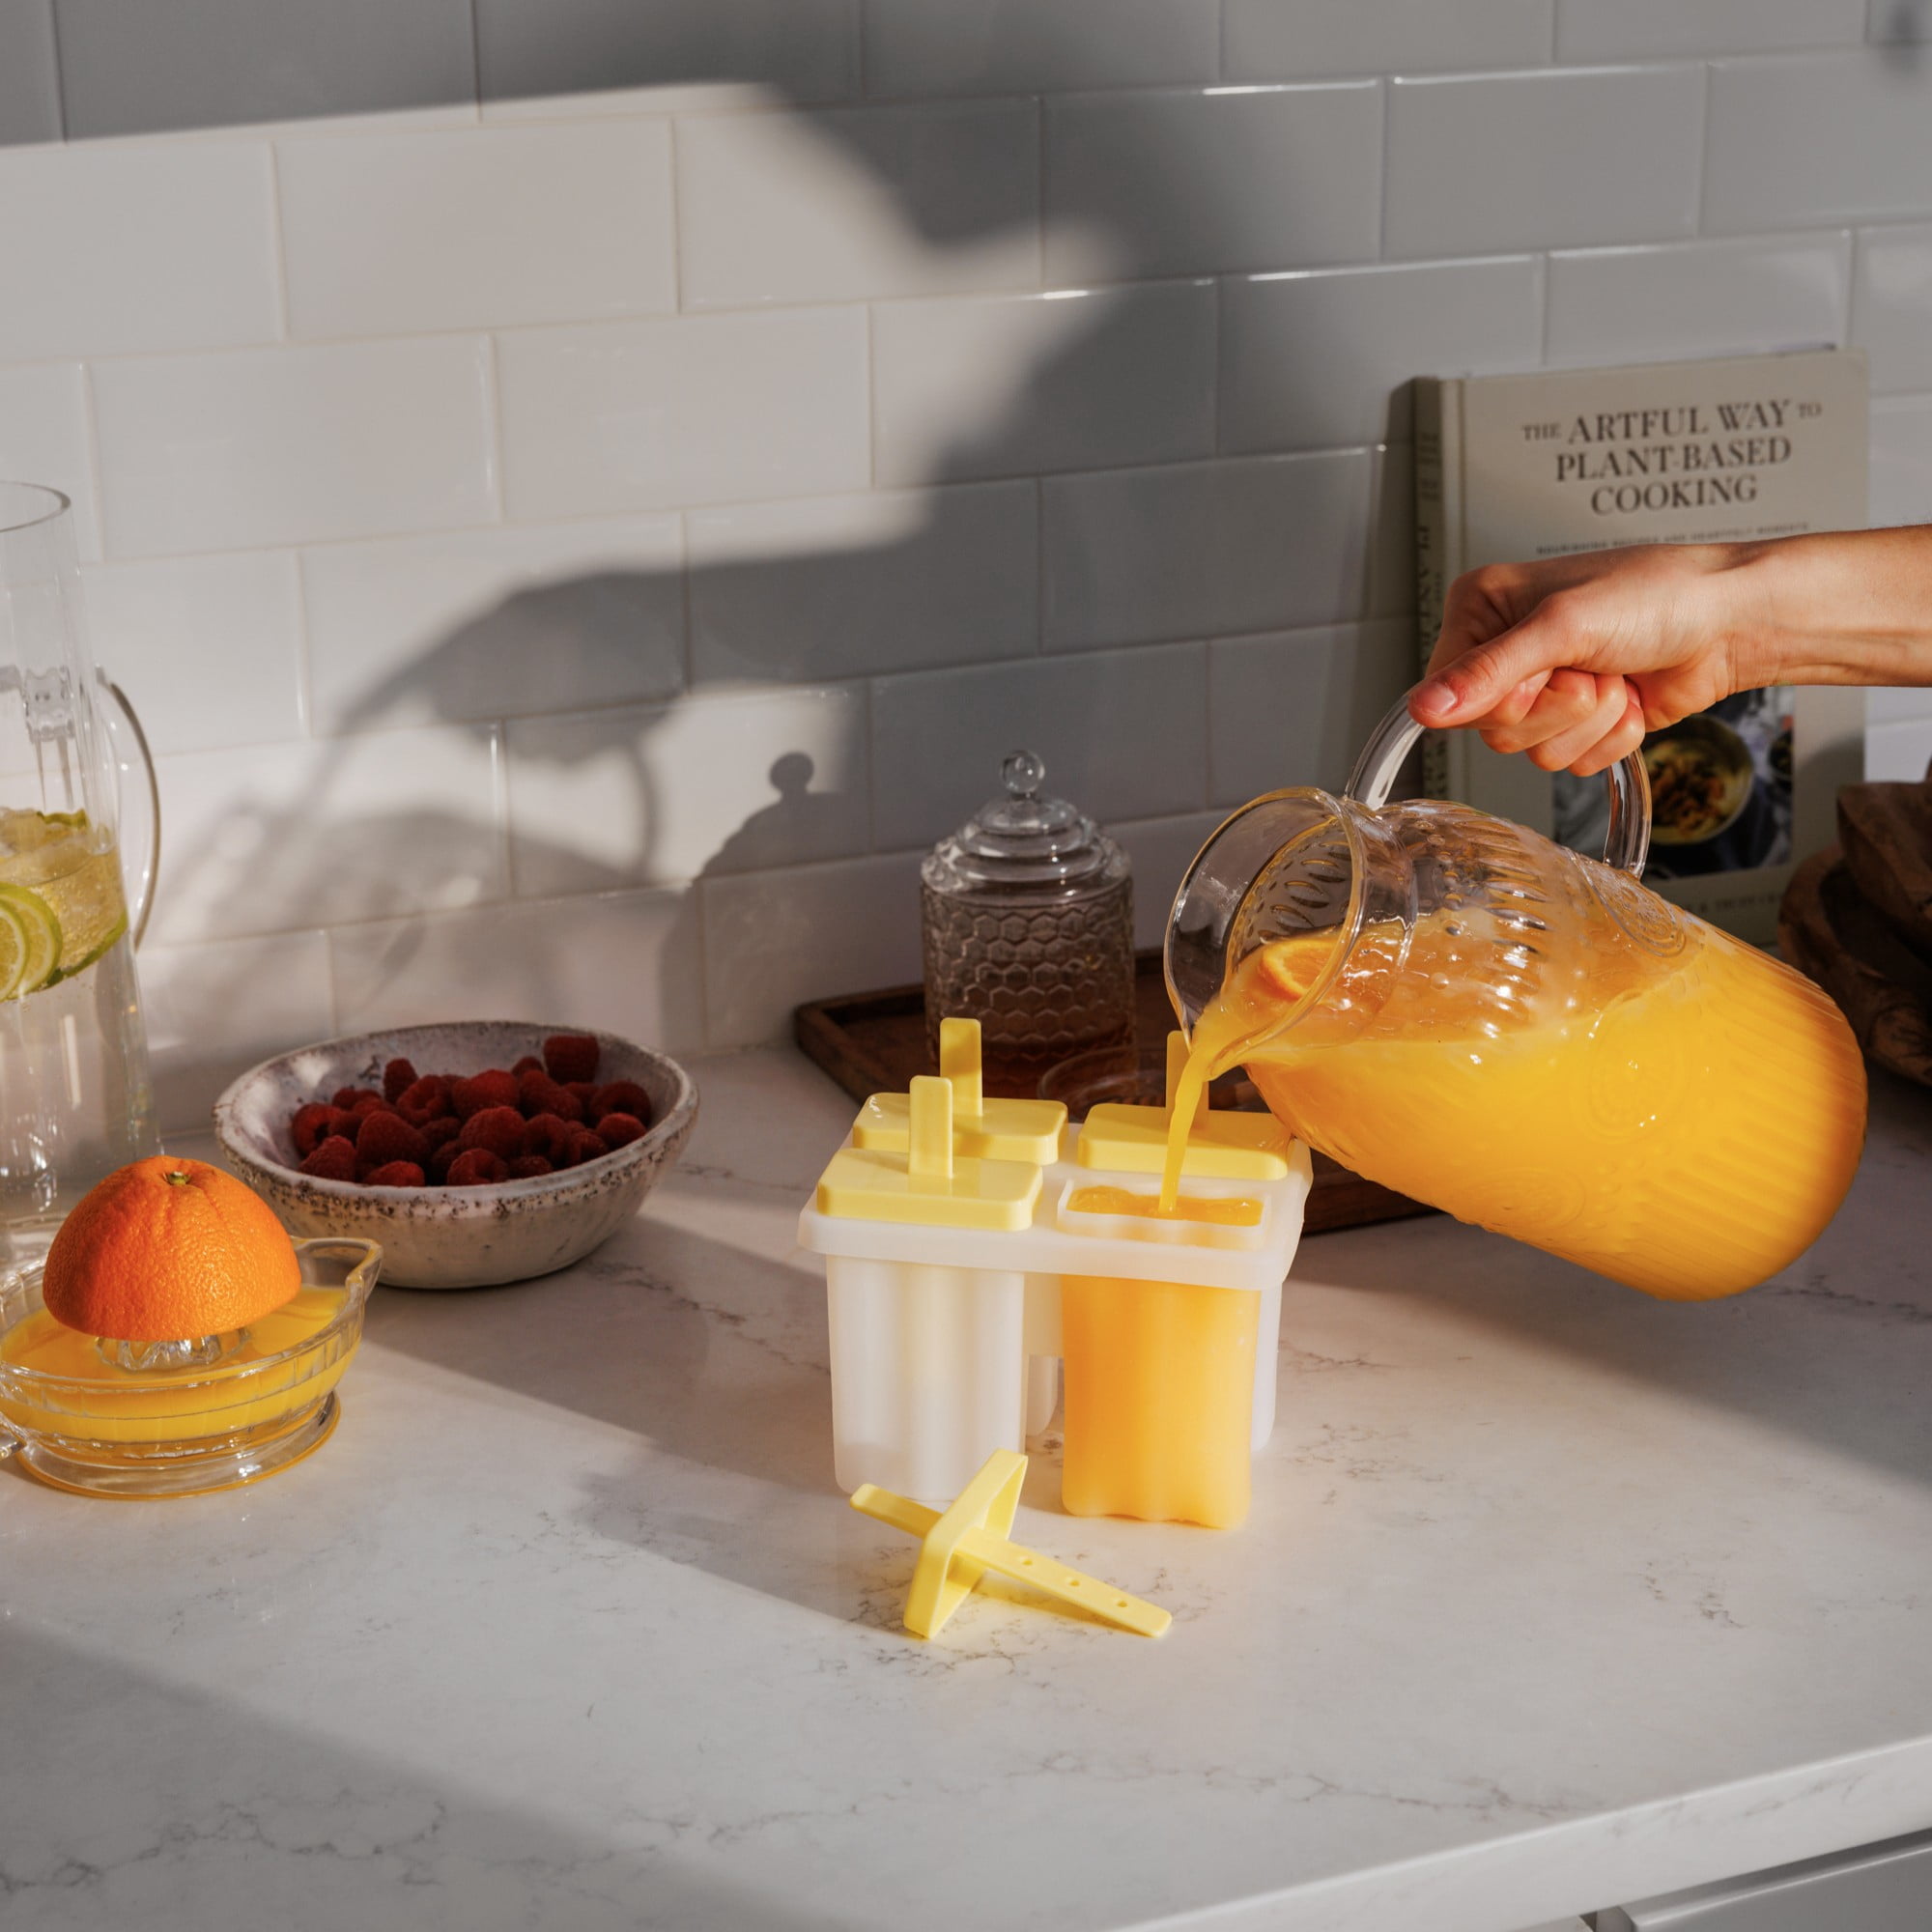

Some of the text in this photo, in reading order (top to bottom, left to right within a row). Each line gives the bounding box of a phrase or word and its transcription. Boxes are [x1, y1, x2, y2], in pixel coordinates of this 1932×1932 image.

[1521, 399, 1822, 444] THE ARTFUL WAY TO
[1555, 437, 1792, 482] PLANT-BASED
[1590, 475, 1757, 517] COOKING
